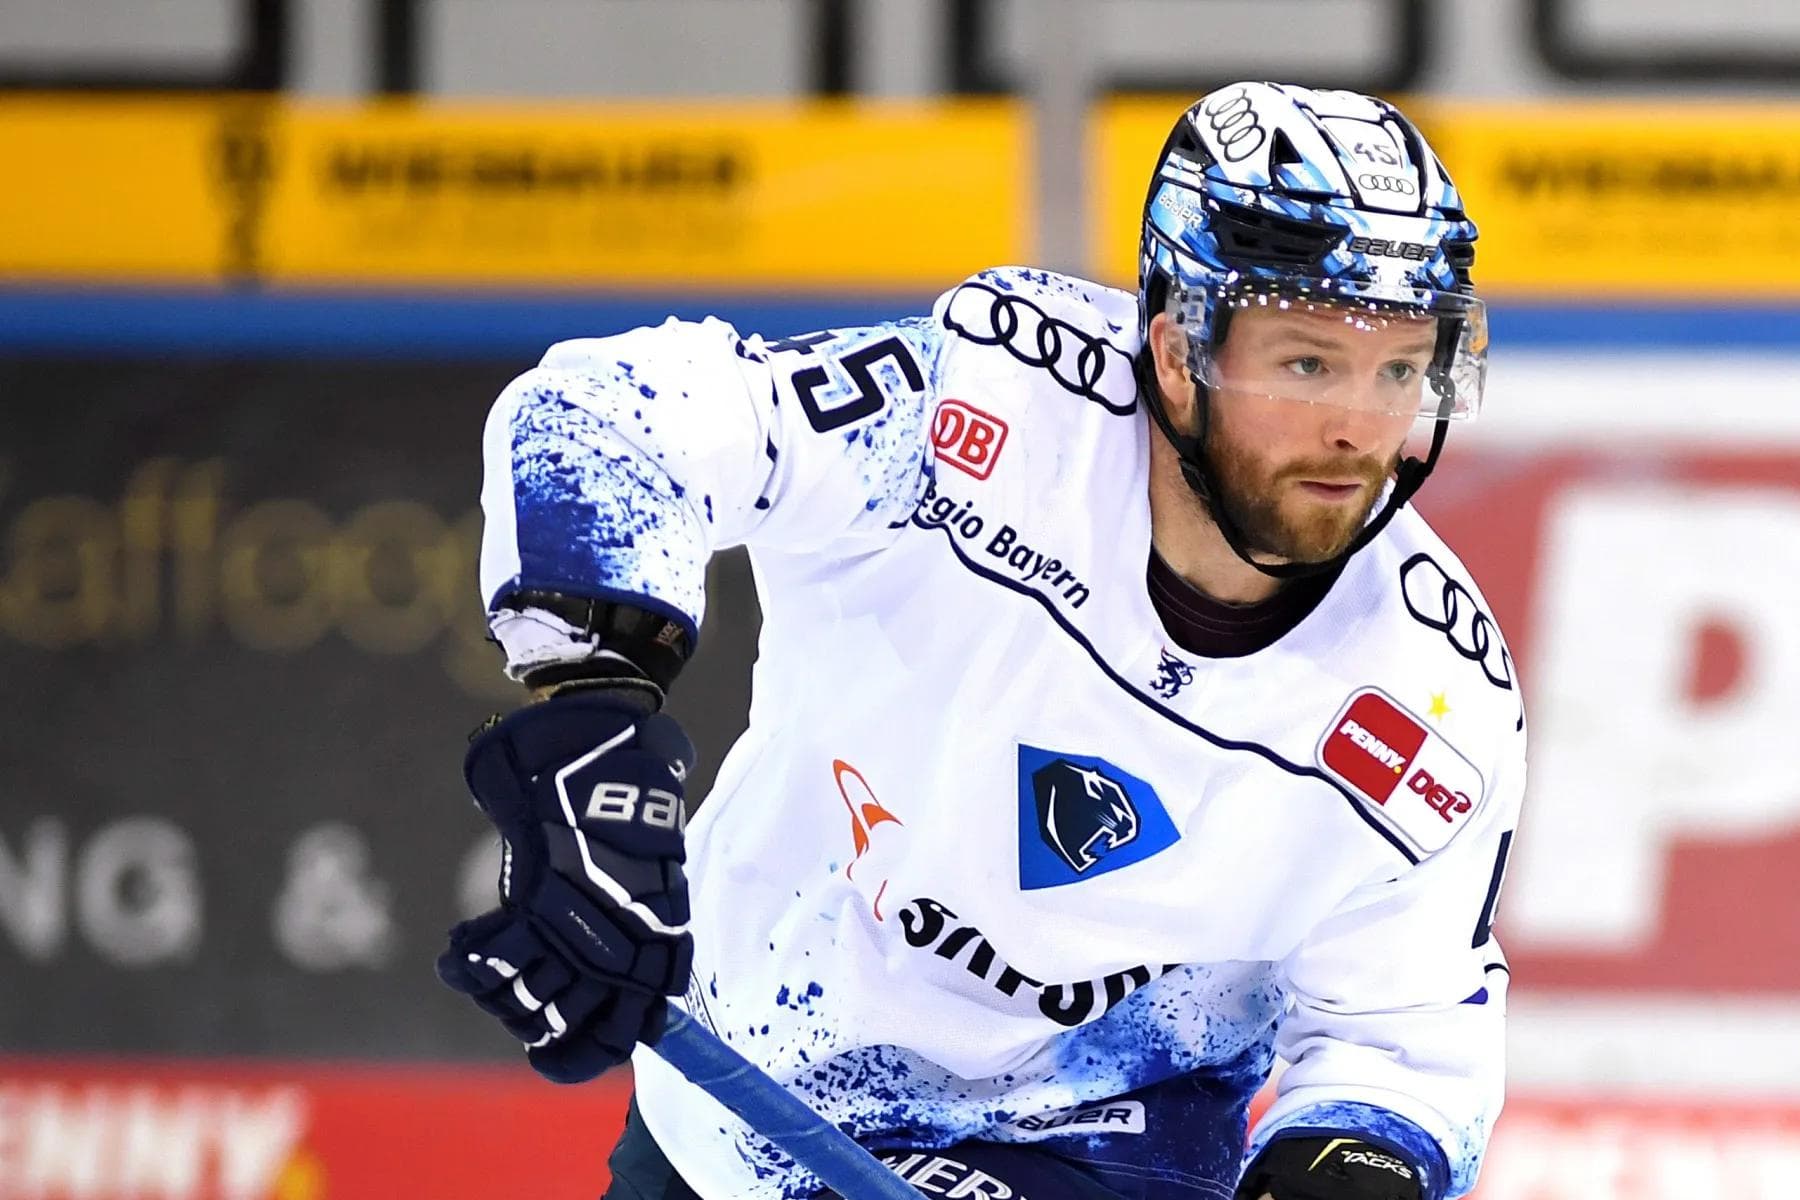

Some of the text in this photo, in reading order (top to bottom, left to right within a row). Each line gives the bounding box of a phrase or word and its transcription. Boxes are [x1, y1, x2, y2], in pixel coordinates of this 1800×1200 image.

[1354, 142, 1398, 165] 45
[1347, 236, 1438, 262] BAUER
[935, 408, 996, 467] DB
[921, 482, 984, 539] egio
[985, 524, 1090, 609] Bayern
[1008, 1107, 1133, 1132] AUER
[1340, 1150, 1413, 1180] TACKS
